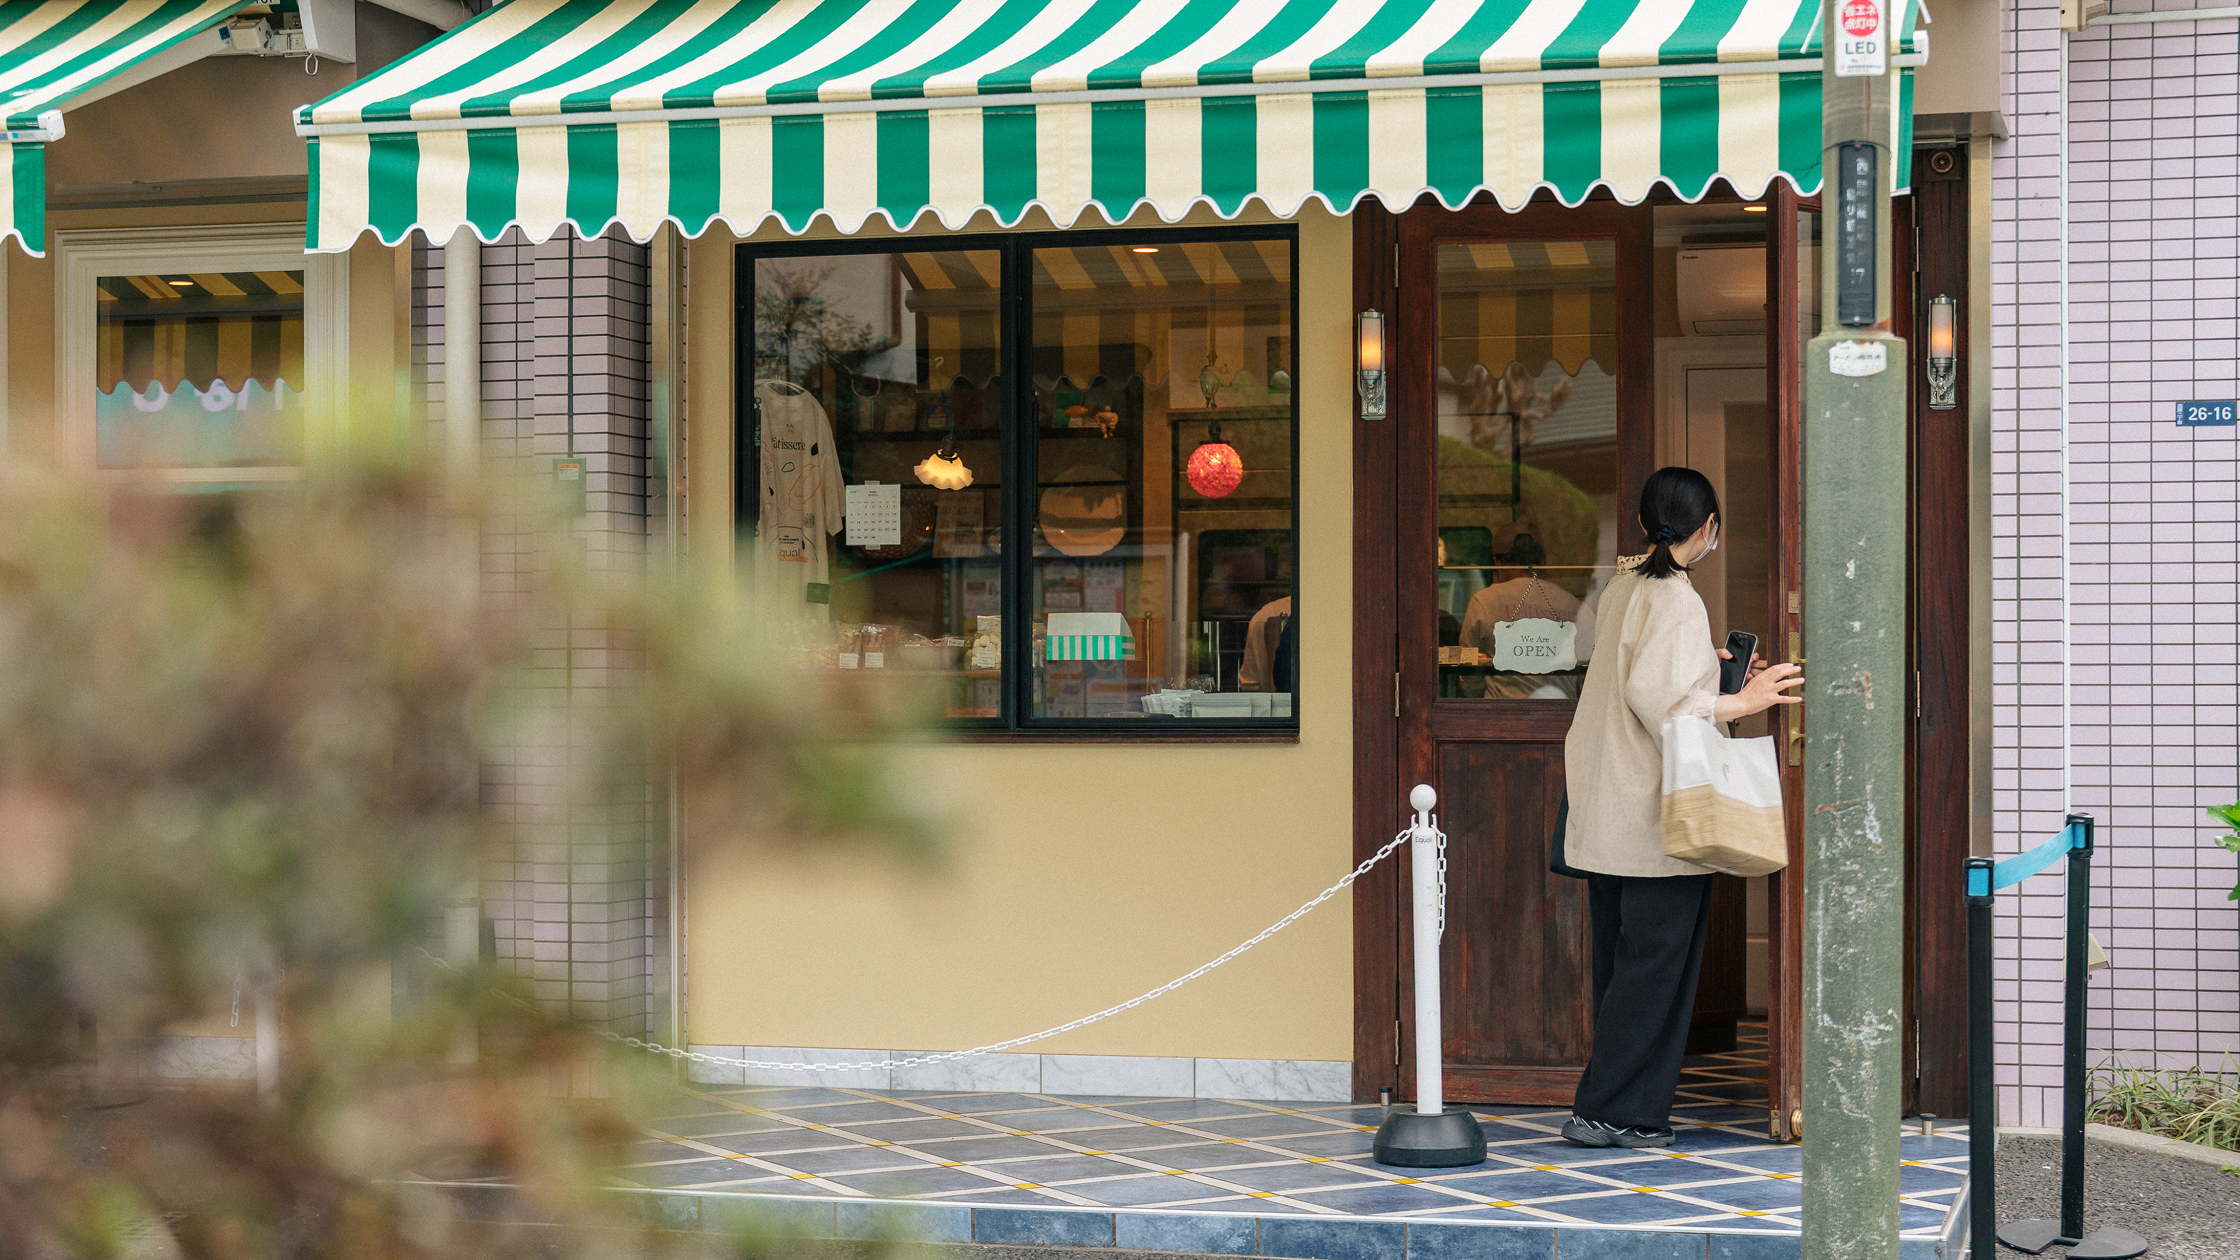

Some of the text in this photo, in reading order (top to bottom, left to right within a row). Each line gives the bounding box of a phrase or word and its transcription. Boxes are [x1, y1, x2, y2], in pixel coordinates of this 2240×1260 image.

[1844, 4, 1876, 17] 省エネ
[1844, 17, 1877, 30] 点灯中
[1845, 41, 1876, 55] LED
[2188, 406, 2232, 421] 26-16
[1521, 635, 1550, 643] We Are
[1513, 645, 1557, 657] OPEN
